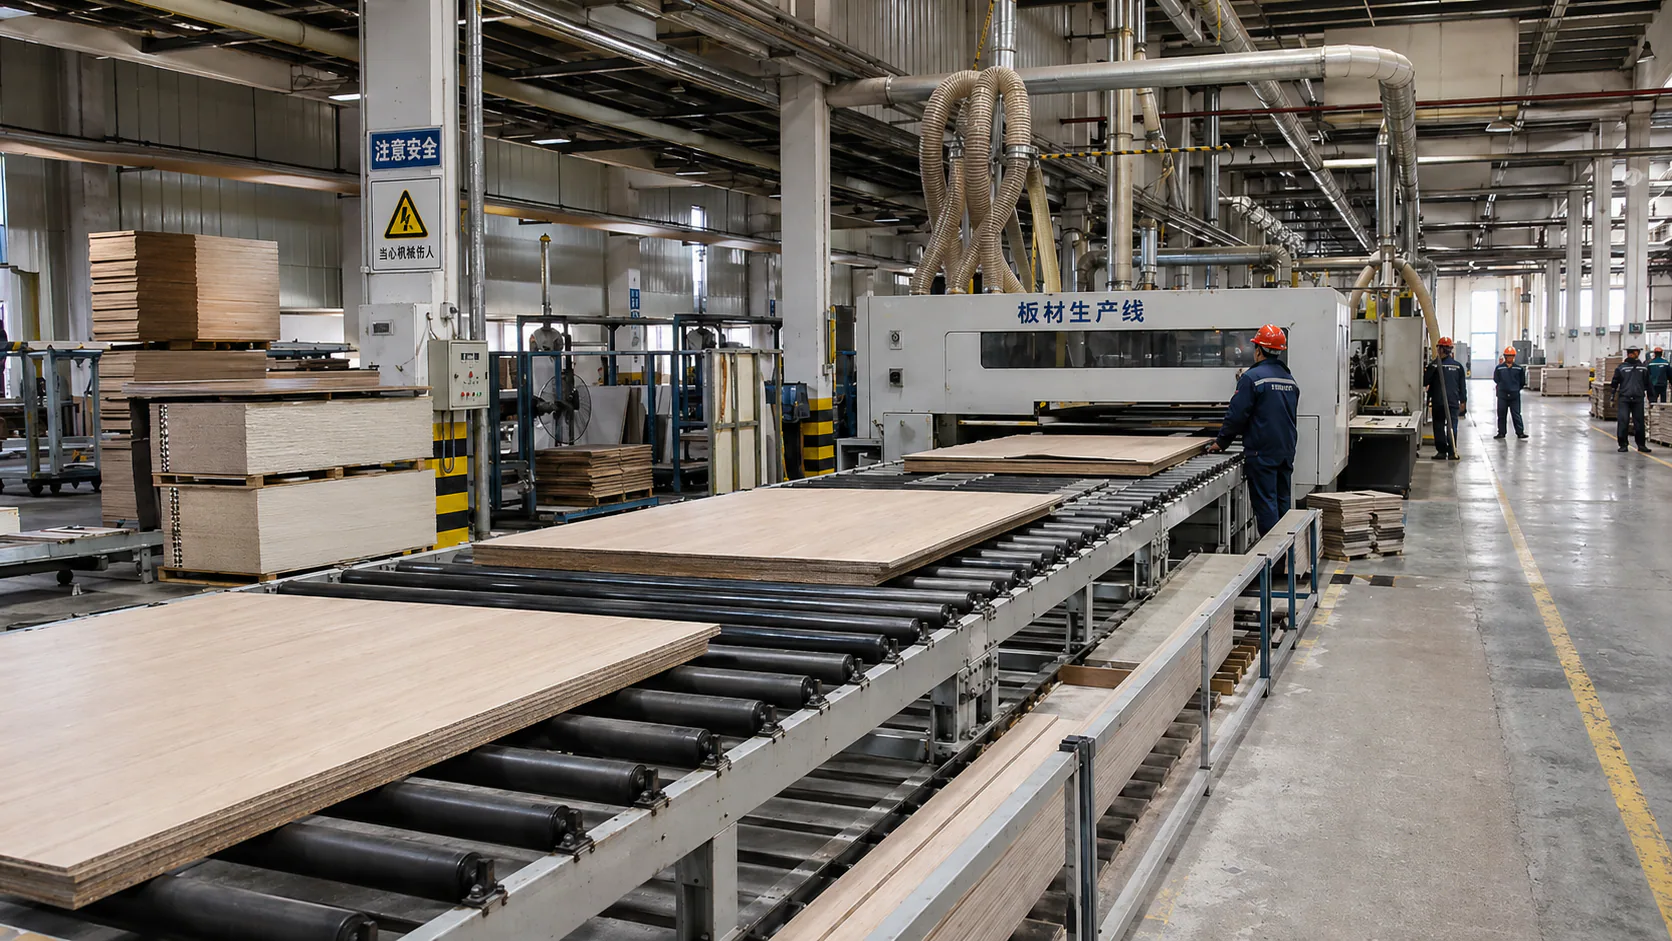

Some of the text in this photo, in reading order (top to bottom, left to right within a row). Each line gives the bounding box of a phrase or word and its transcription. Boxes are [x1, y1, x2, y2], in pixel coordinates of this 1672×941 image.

[375, 137, 437, 162] 注意安全
[1017, 299, 1145, 324] 板材生产线
